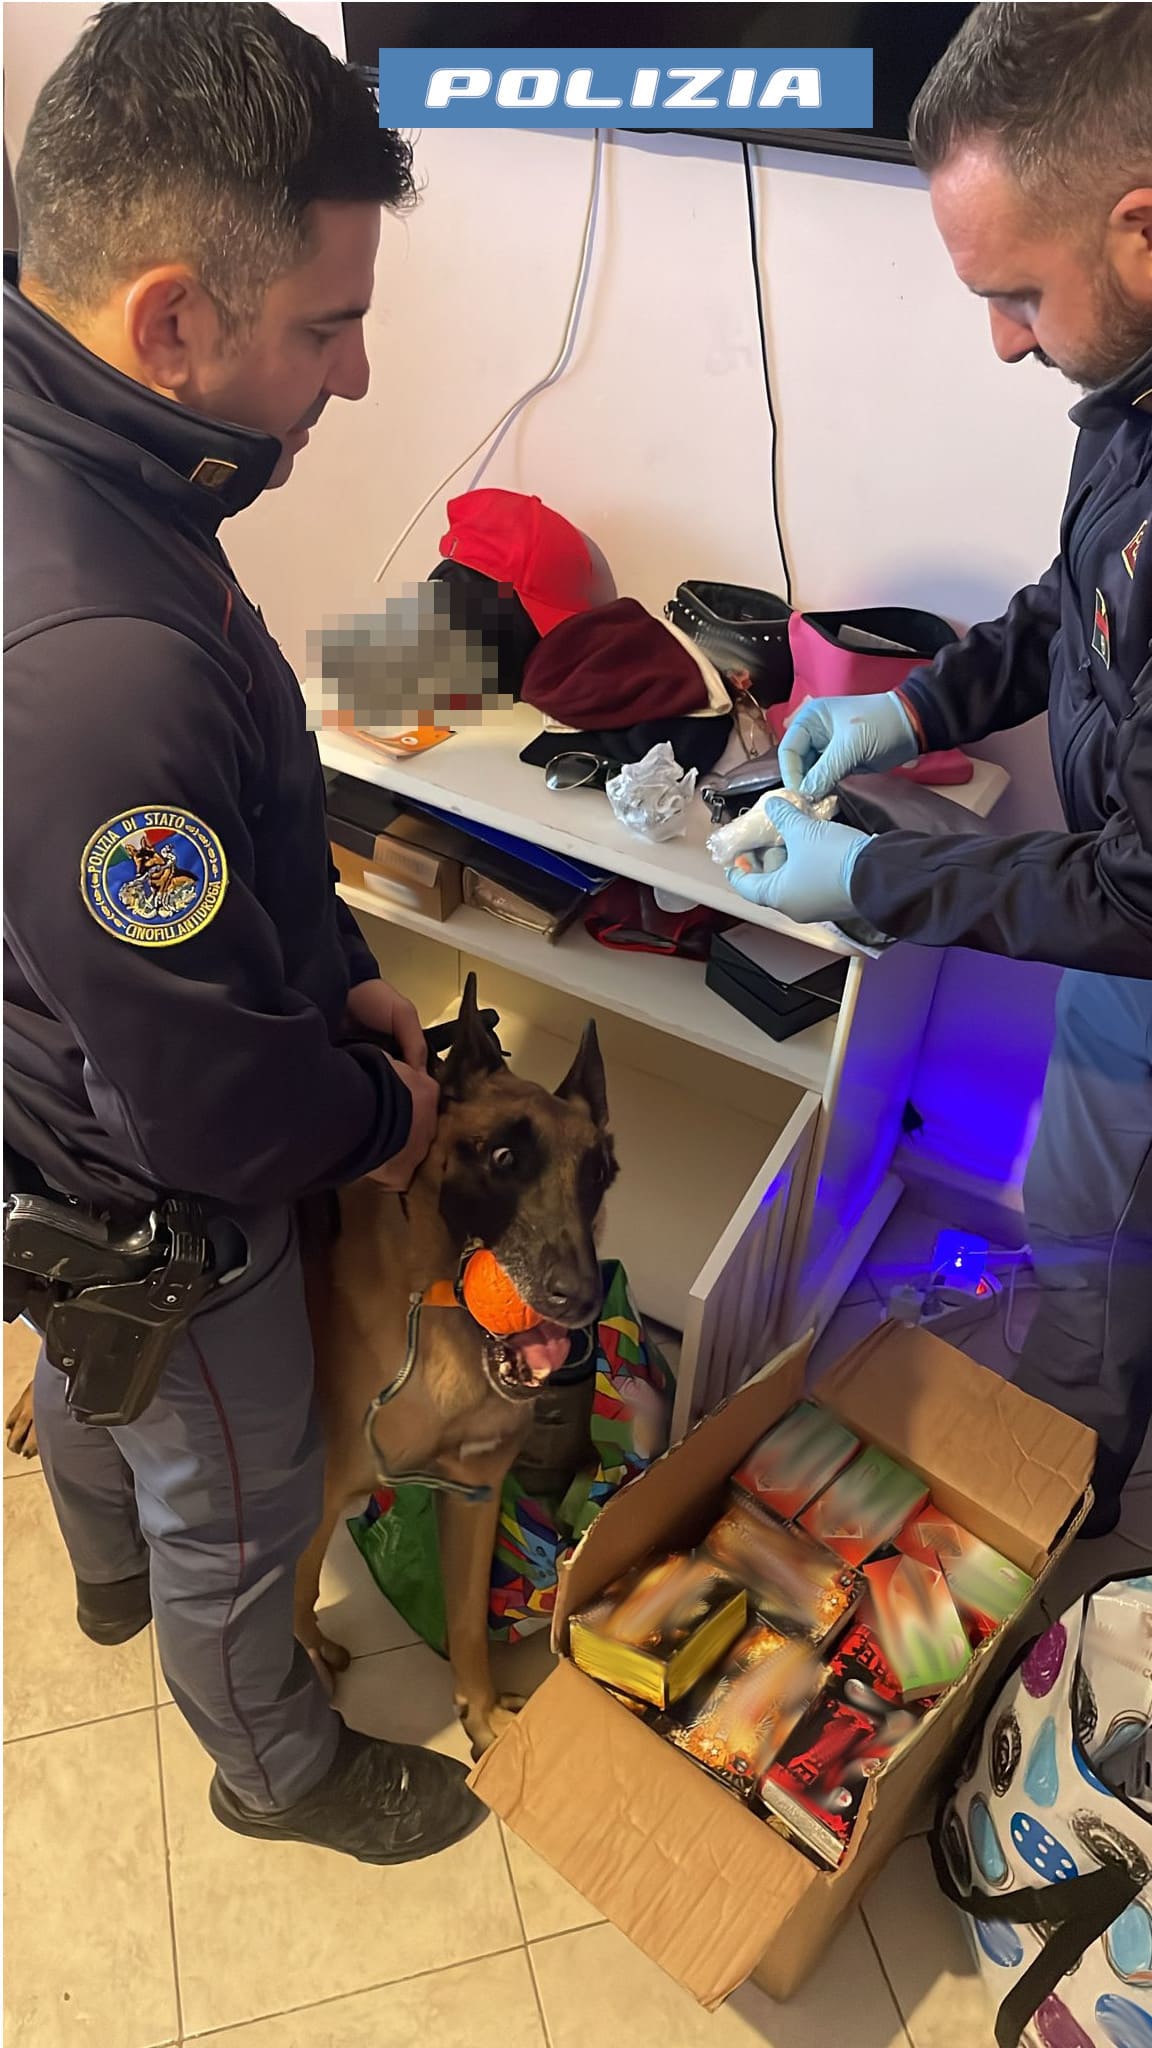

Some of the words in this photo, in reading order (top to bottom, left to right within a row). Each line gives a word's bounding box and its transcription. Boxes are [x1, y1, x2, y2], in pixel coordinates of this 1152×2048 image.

[88, 831, 120, 873] POLIZIA
[122, 817, 137, 832] DI
[145, 812, 185, 829] STATO
[125, 923, 175, 941] CINOFILI
[177, 880, 221, 936] ANTIDROGA
